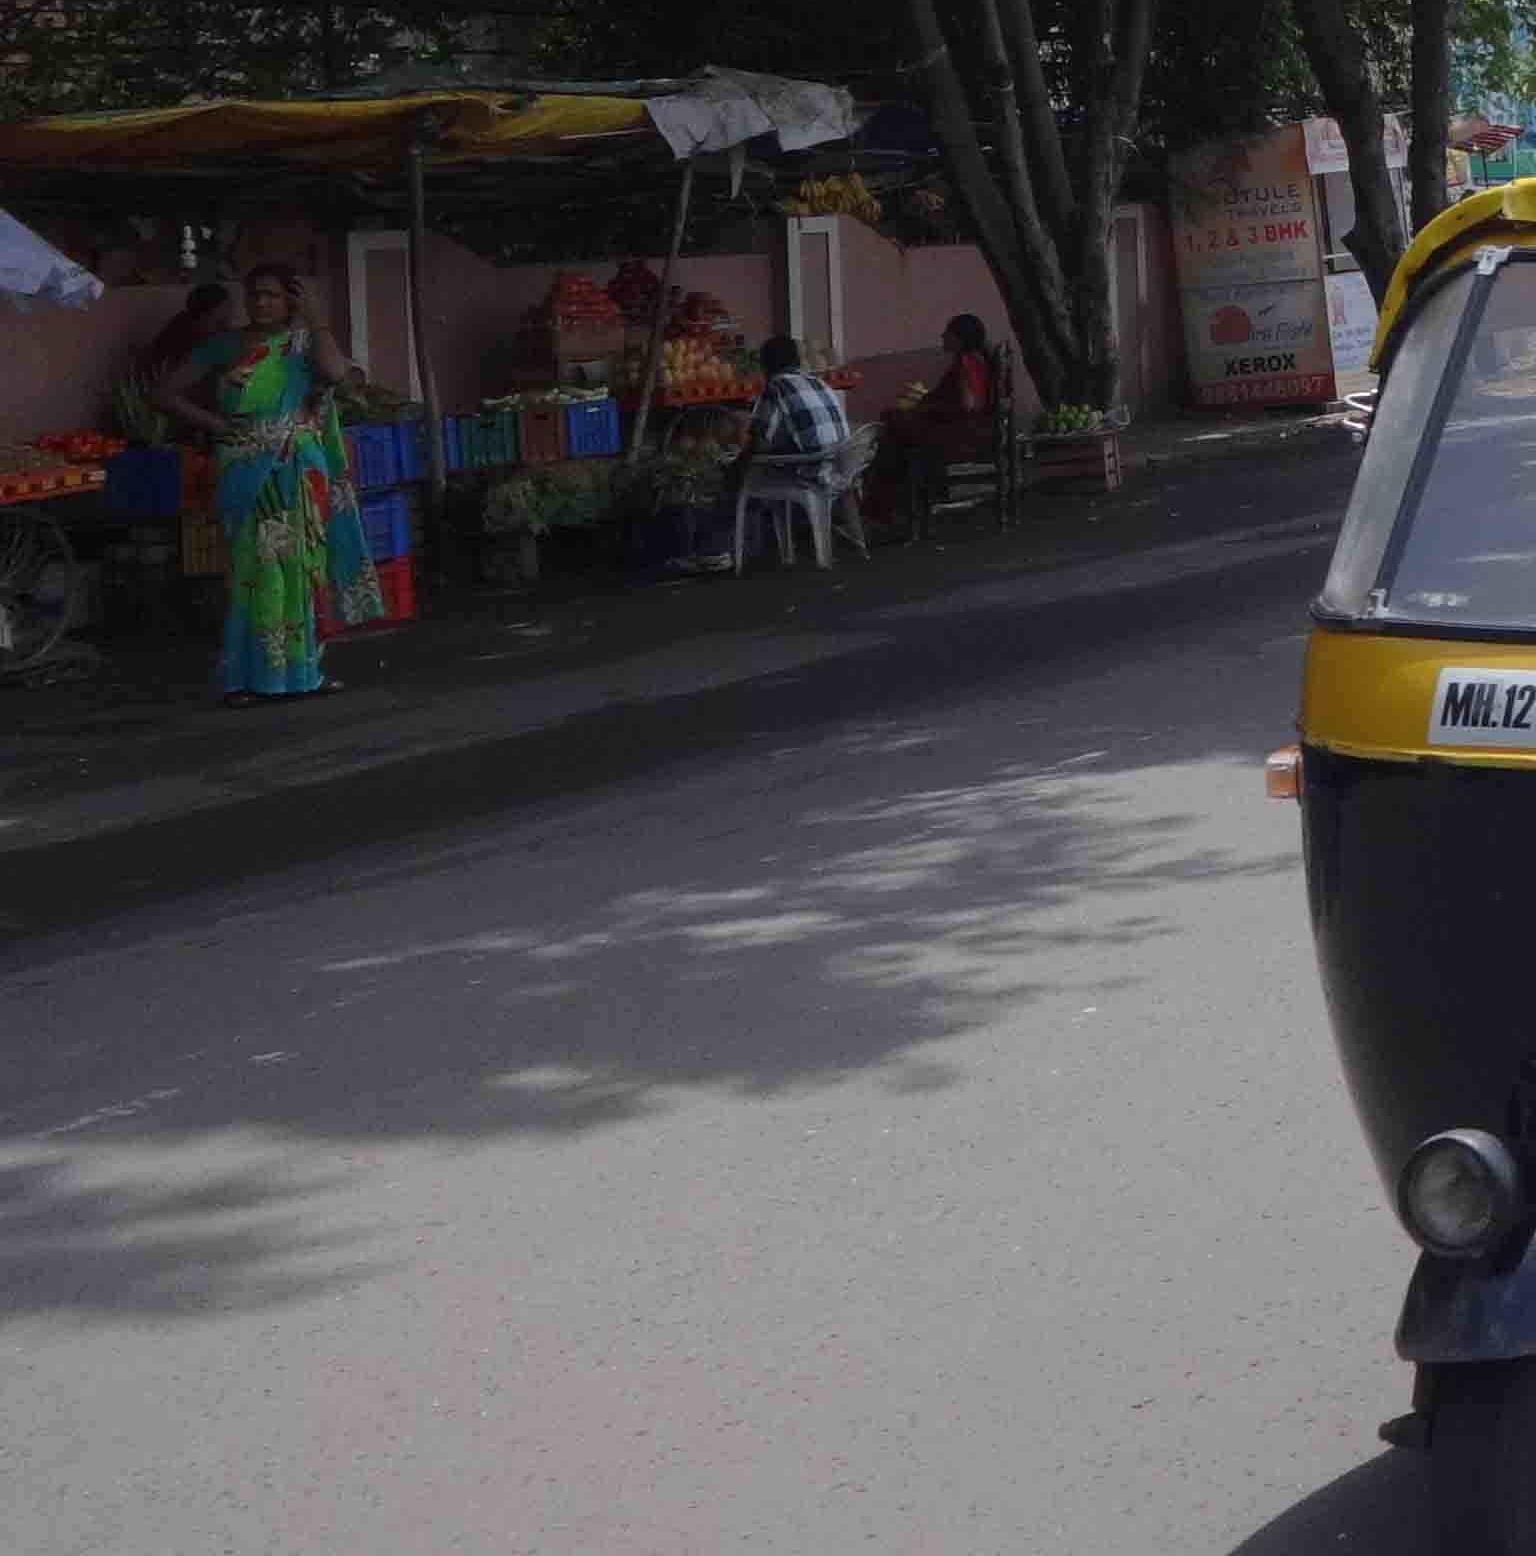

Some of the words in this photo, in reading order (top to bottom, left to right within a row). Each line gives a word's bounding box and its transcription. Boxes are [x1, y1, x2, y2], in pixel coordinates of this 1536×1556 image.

[1263, 219, 1308, 243] BHK
[1224, 352, 1297, 378] XEROX
[1440, 682, 1536, 730] MH.12
